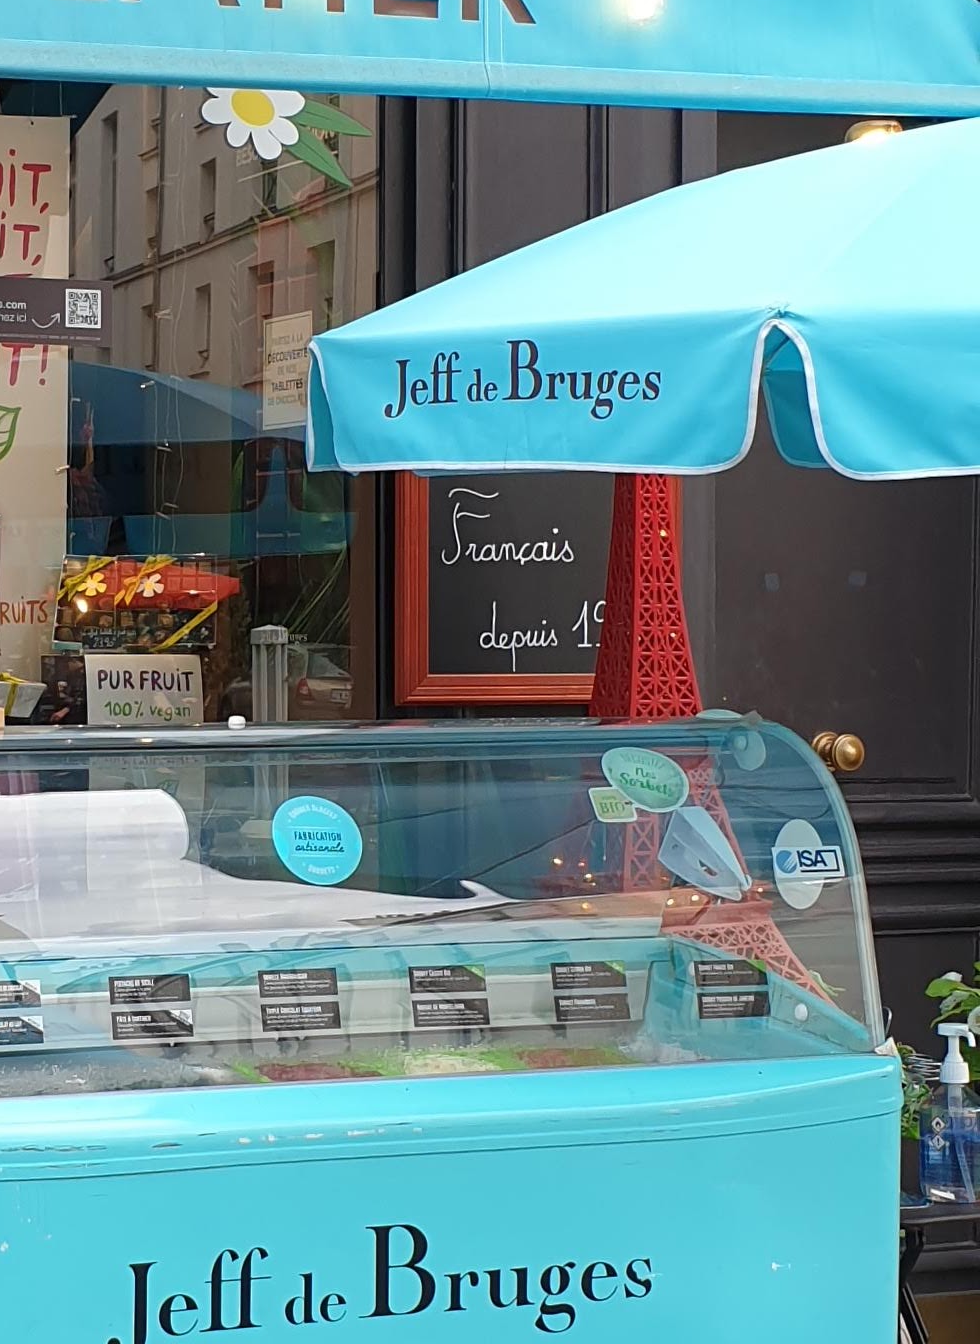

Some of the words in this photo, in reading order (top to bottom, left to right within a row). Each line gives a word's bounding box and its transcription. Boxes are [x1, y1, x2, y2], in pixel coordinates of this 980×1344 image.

[16, 312, 27, 323] ici
[384, 352, 465, 420] Jeff
[467, 368, 498, 403] de
[501, 340, 662, 422] Bruges
[441, 488, 575, 565] Français
[0, 596, 48, 625] RUITS
[479, 600, 558, 673] depuis
[97, 669, 134, 692] PUR
[103, 700, 145, 719] 100%
[149, 703, 192, 722] vegan
[293, 831, 342, 842] FABRICATION
[796, 849, 828, 868] ISA
[284, 1273, 348, 1327] de
[357, 1223, 655, 1334] Bruges
